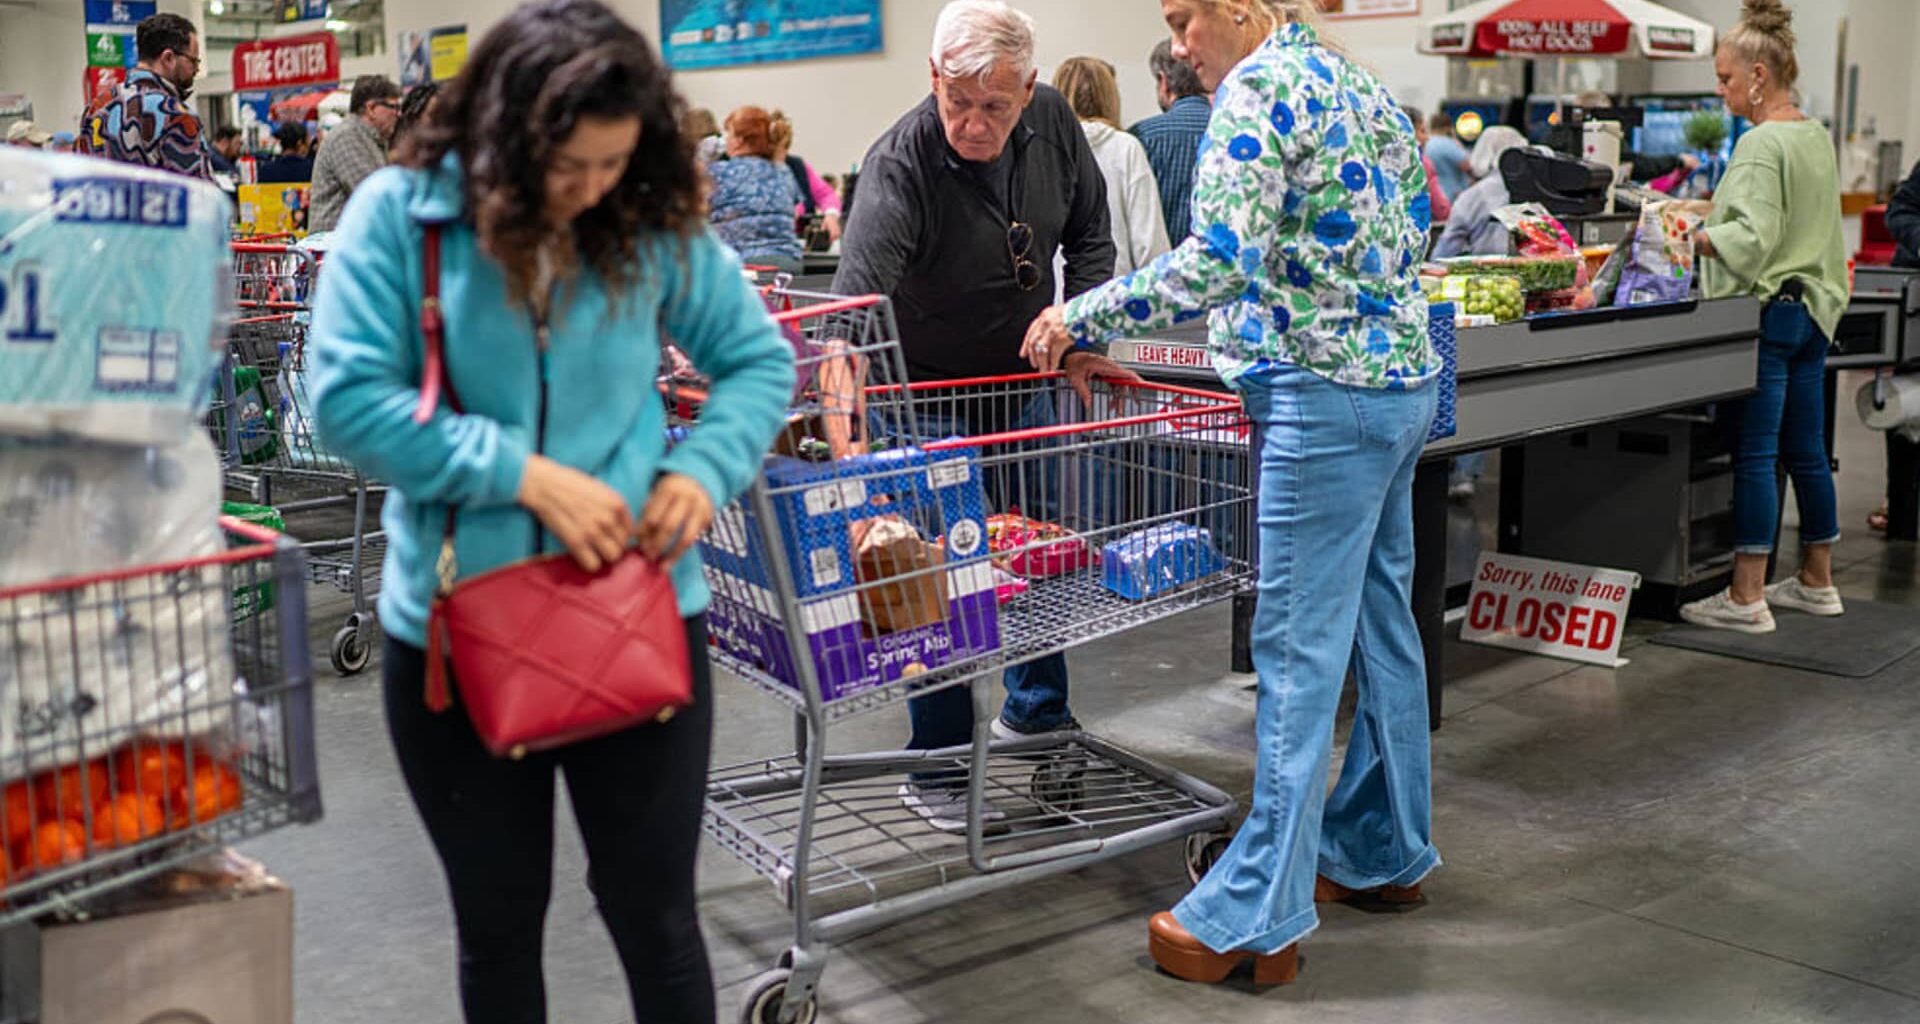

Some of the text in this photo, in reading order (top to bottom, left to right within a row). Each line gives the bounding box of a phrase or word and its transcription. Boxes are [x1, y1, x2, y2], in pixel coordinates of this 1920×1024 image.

[1497, 20, 1608, 37] 100% ALL BEEF
[1508, 34, 1594, 50] HOT DOGS
[242, 41, 328, 83] TIRE CENTER
[1136, 345, 1169, 362] LEAVE
[1170, 347, 1205, 367] HEAVY
[1479, 561, 1627, 603] Sorry, this lane
[1469, 591, 1617, 651] CLOSED
[882, 626, 937, 651] ORGANIC
[867, 642, 921, 670] Spring
